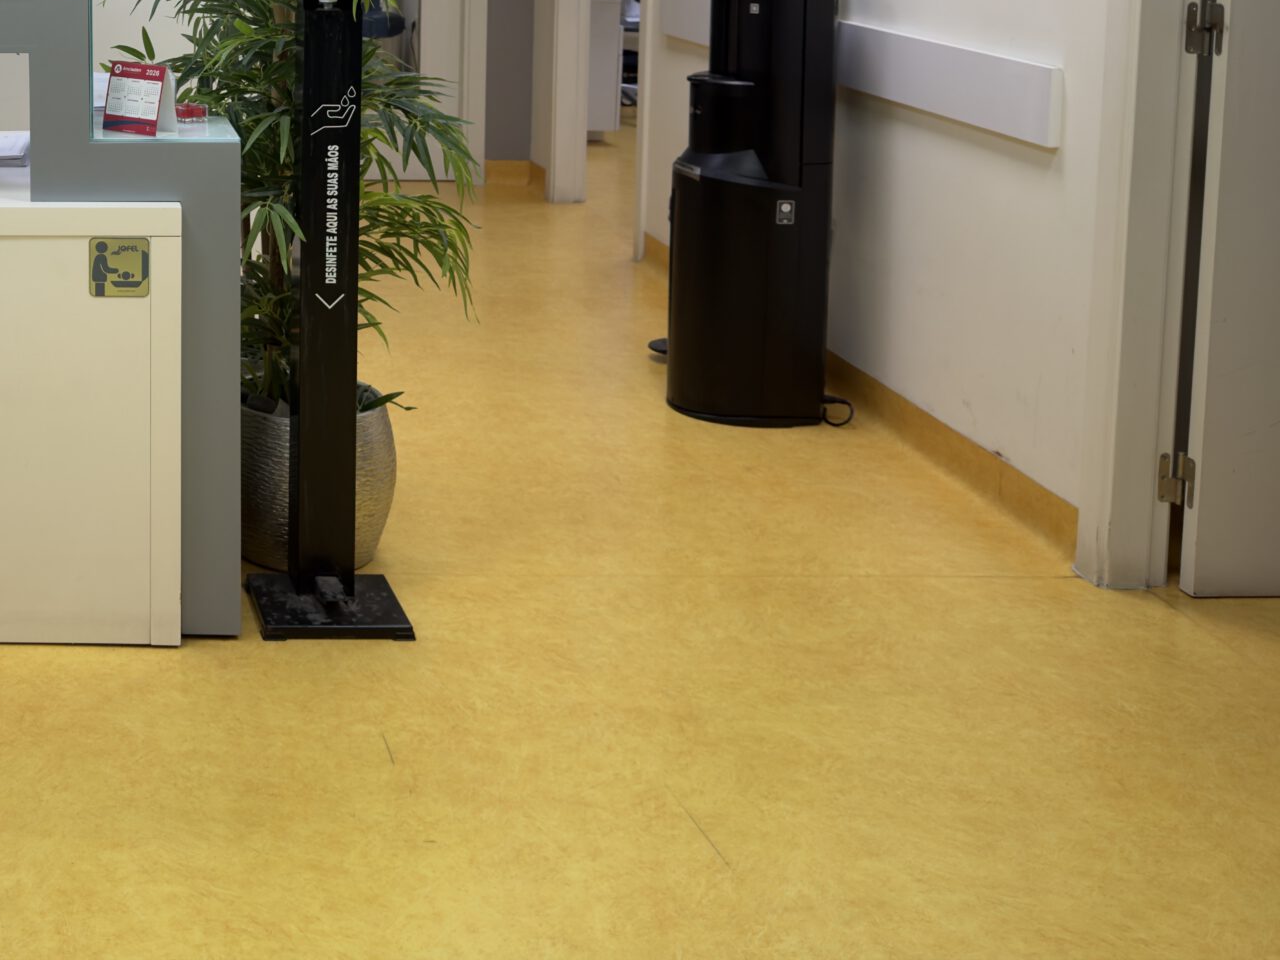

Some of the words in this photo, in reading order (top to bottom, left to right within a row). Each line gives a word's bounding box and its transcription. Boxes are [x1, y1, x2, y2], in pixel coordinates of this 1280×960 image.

[325, 144, 340, 171] MÃOS
[326, 172, 339, 196] SUAS
[326, 197, 338, 210] AS
[326, 211, 338, 234] AQUI
[111, 245, 140, 256] JOFEL
[325, 235, 338, 284] DESINFETE
